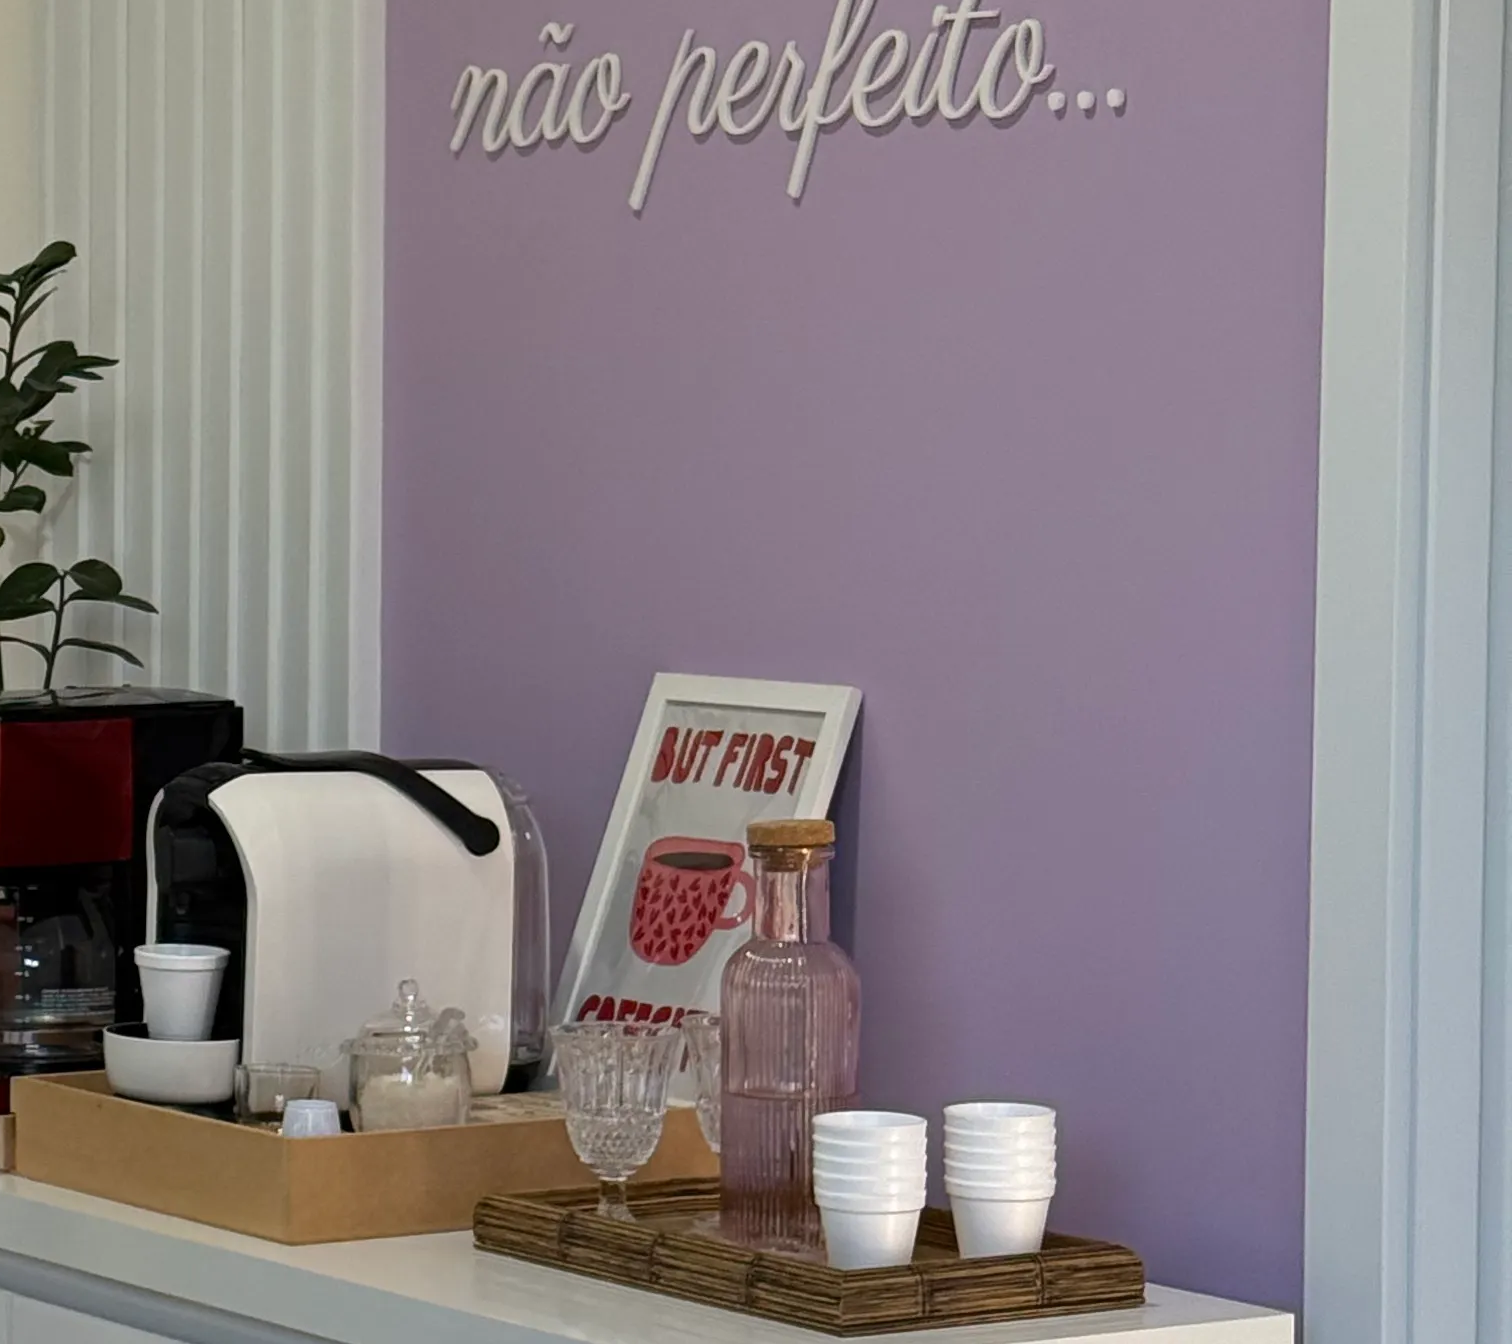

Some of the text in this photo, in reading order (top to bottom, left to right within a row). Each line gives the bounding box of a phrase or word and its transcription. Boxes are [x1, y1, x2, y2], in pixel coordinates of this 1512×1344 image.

[451, 22, 631, 151] não
[651, 726, 817, 796] BUT FIRST
